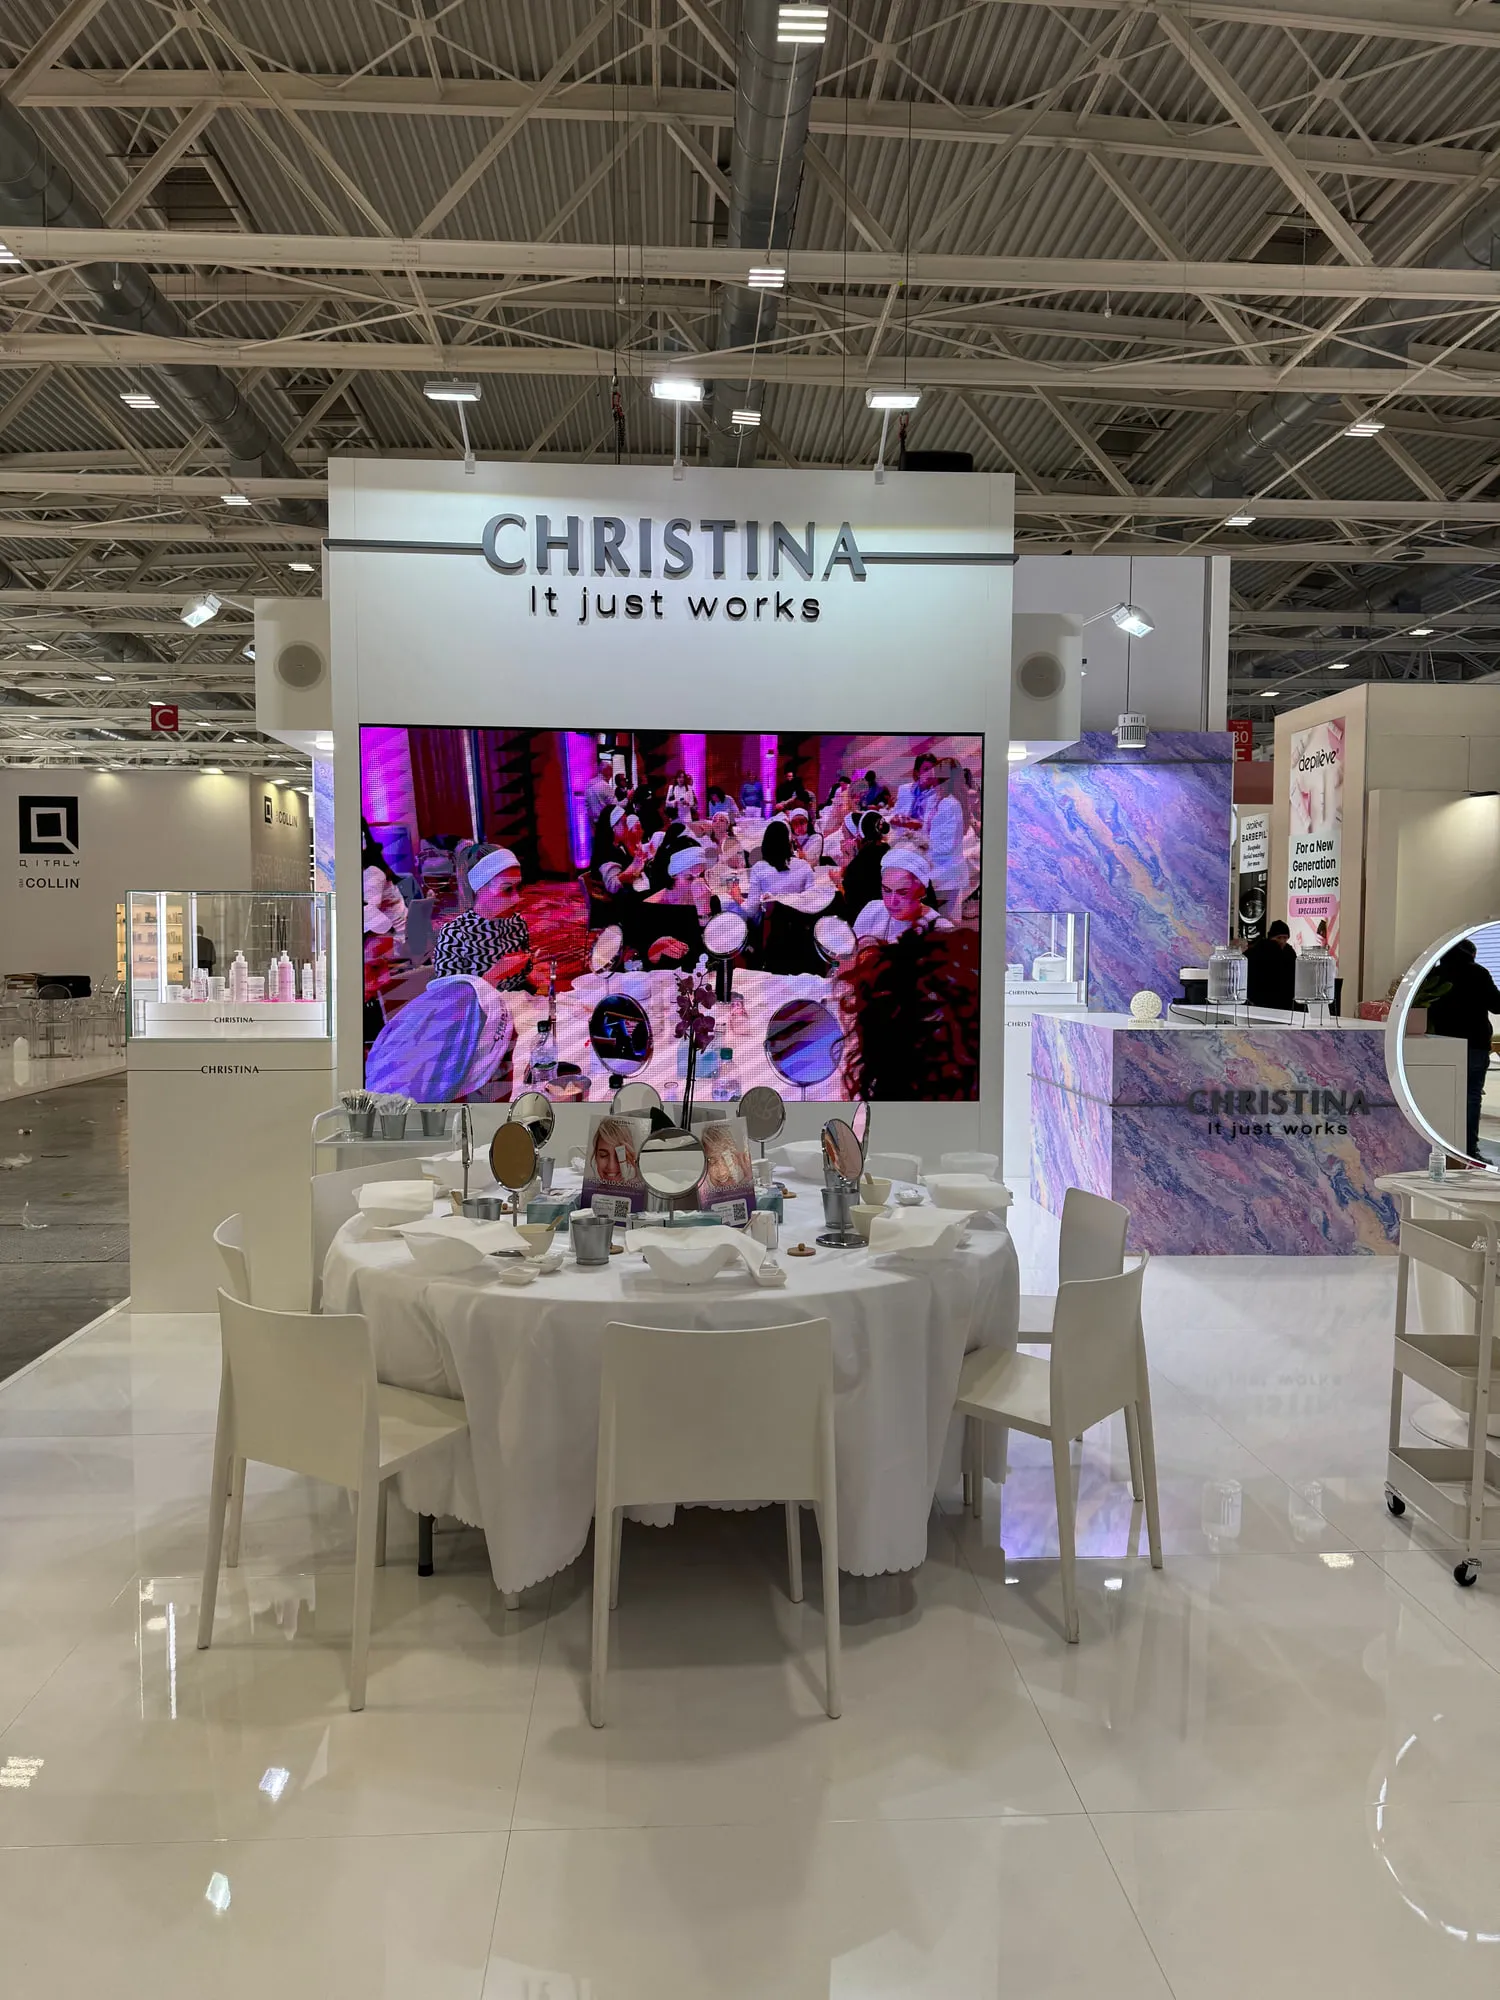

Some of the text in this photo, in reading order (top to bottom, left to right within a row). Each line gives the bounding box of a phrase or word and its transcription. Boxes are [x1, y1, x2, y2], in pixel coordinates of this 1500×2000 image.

[482, 513, 867, 579] CHRISTINA
[530, 585, 822, 622] It just works
[155, 708, 175, 730] C
[1298, 749, 1337, 773] depilève
[1241, 831, 1267, 842] BARBEPIL
[1295, 839, 1335, 855] For a New
[1292, 857, 1336, 872] Generation
[25, 877, 79, 889] COLLIN
[1289, 875, 1340, 893] of Depilovers
[1295, 896, 1330, 905] HAIR REMOVAL
[1298, 906, 1328, 915] SPECIALISTS
[214, 1016, 254, 1024] CHRISTINA
[201, 1065, 259, 1074] CHRISTINA
[1186, 1089, 1371, 1116] CHRISTINA
[1207, 1121, 1348, 1139] It just works
